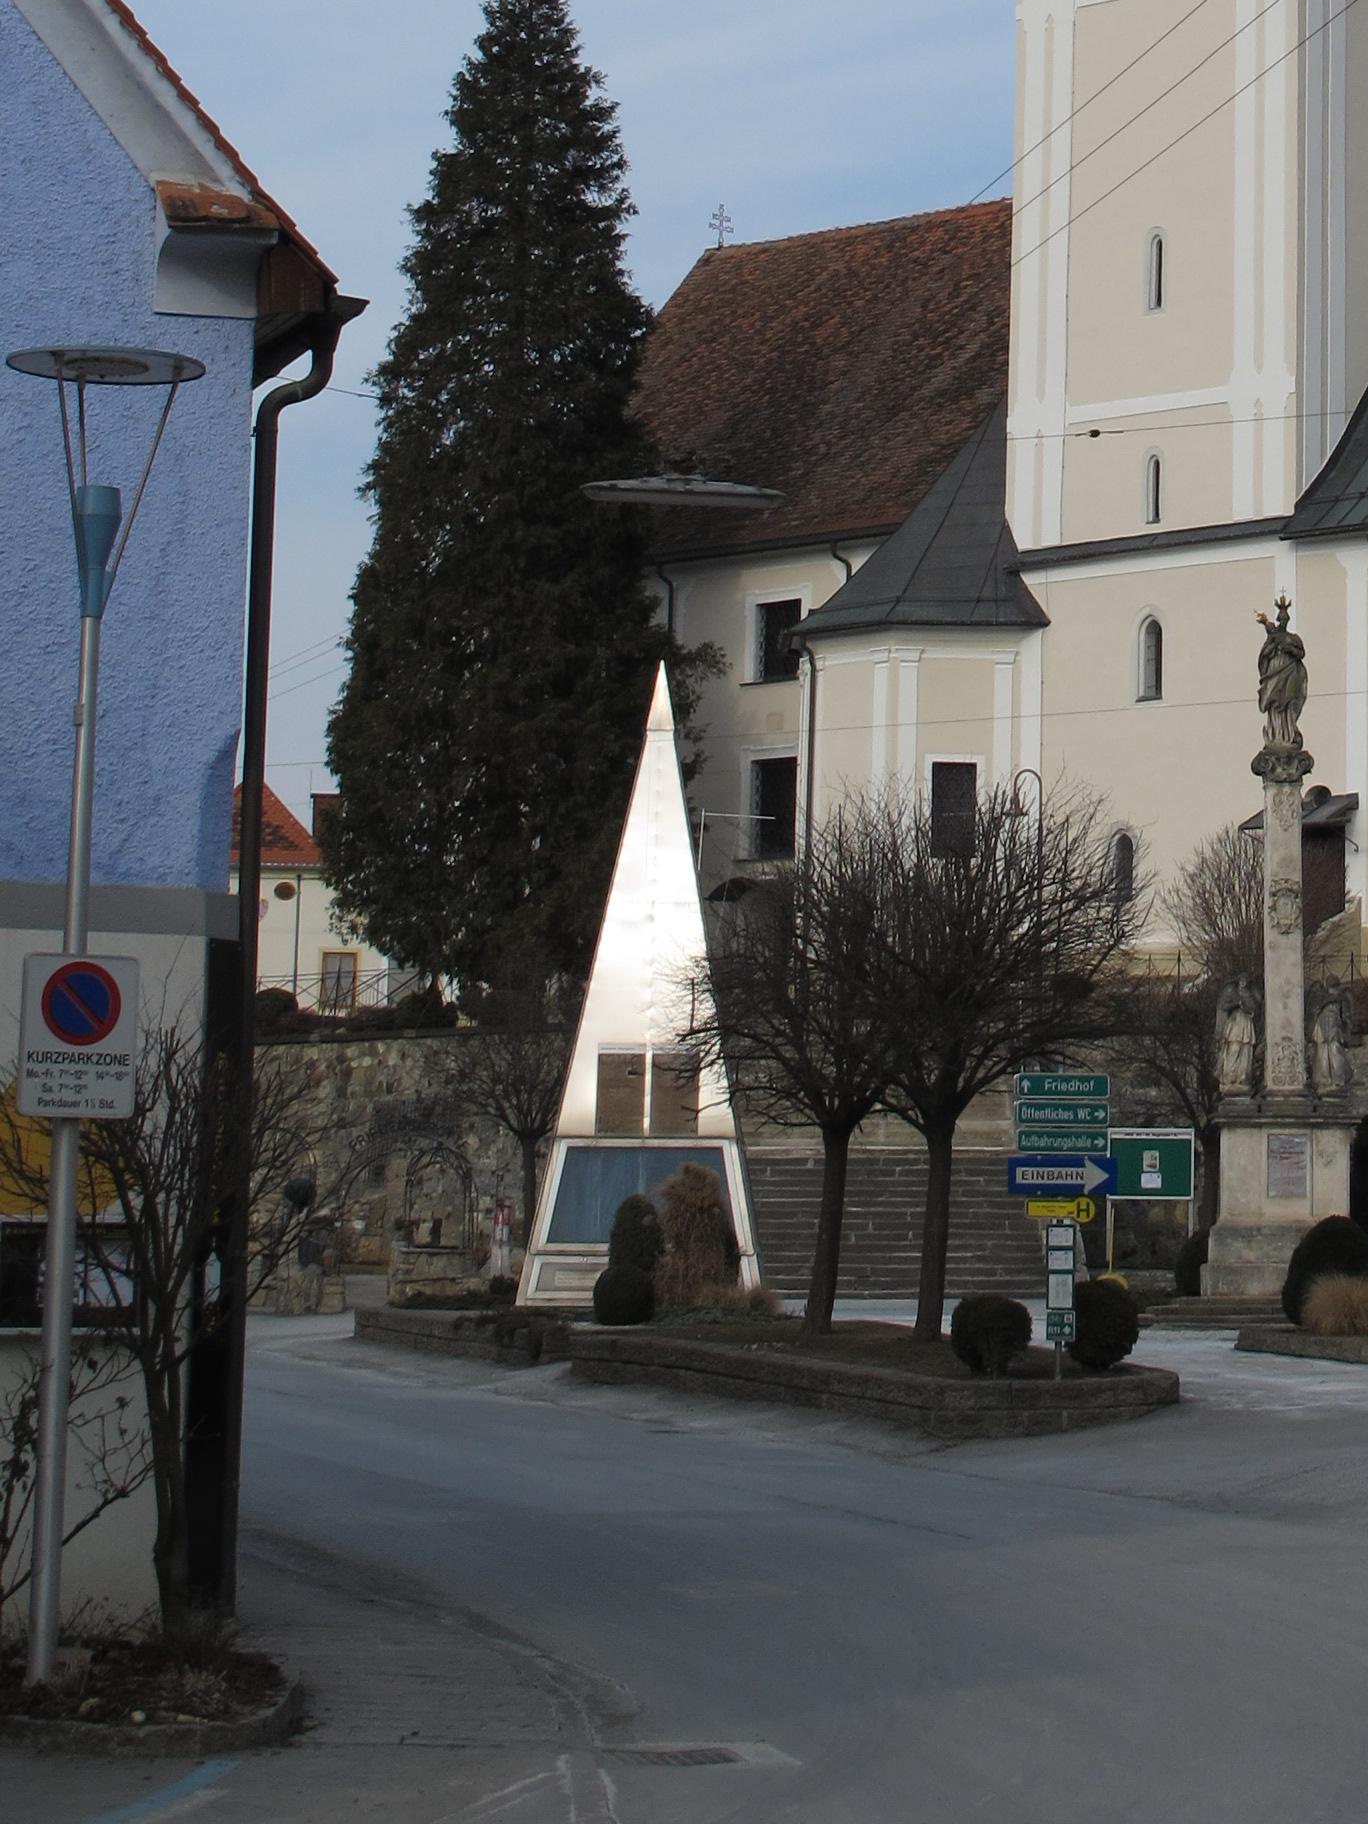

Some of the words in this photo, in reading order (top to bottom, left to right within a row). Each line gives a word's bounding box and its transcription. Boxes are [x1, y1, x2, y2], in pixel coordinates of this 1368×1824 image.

[27, 1050, 131, 1066] KURZPARKZONE
[1044, 1079, 1095, 1092] Friedhof
[38, 1097, 81, 1109] Parkdauer
[1021, 1106, 1074, 1120] Öffentliches
[1077, 1107, 1091, 1120] WC
[1021, 1134, 1091, 1150] Aufbahrungshalle
[1021, 1170, 1084, 1181] EINBAHN
[1077, 1201, 1091, 1219] H
